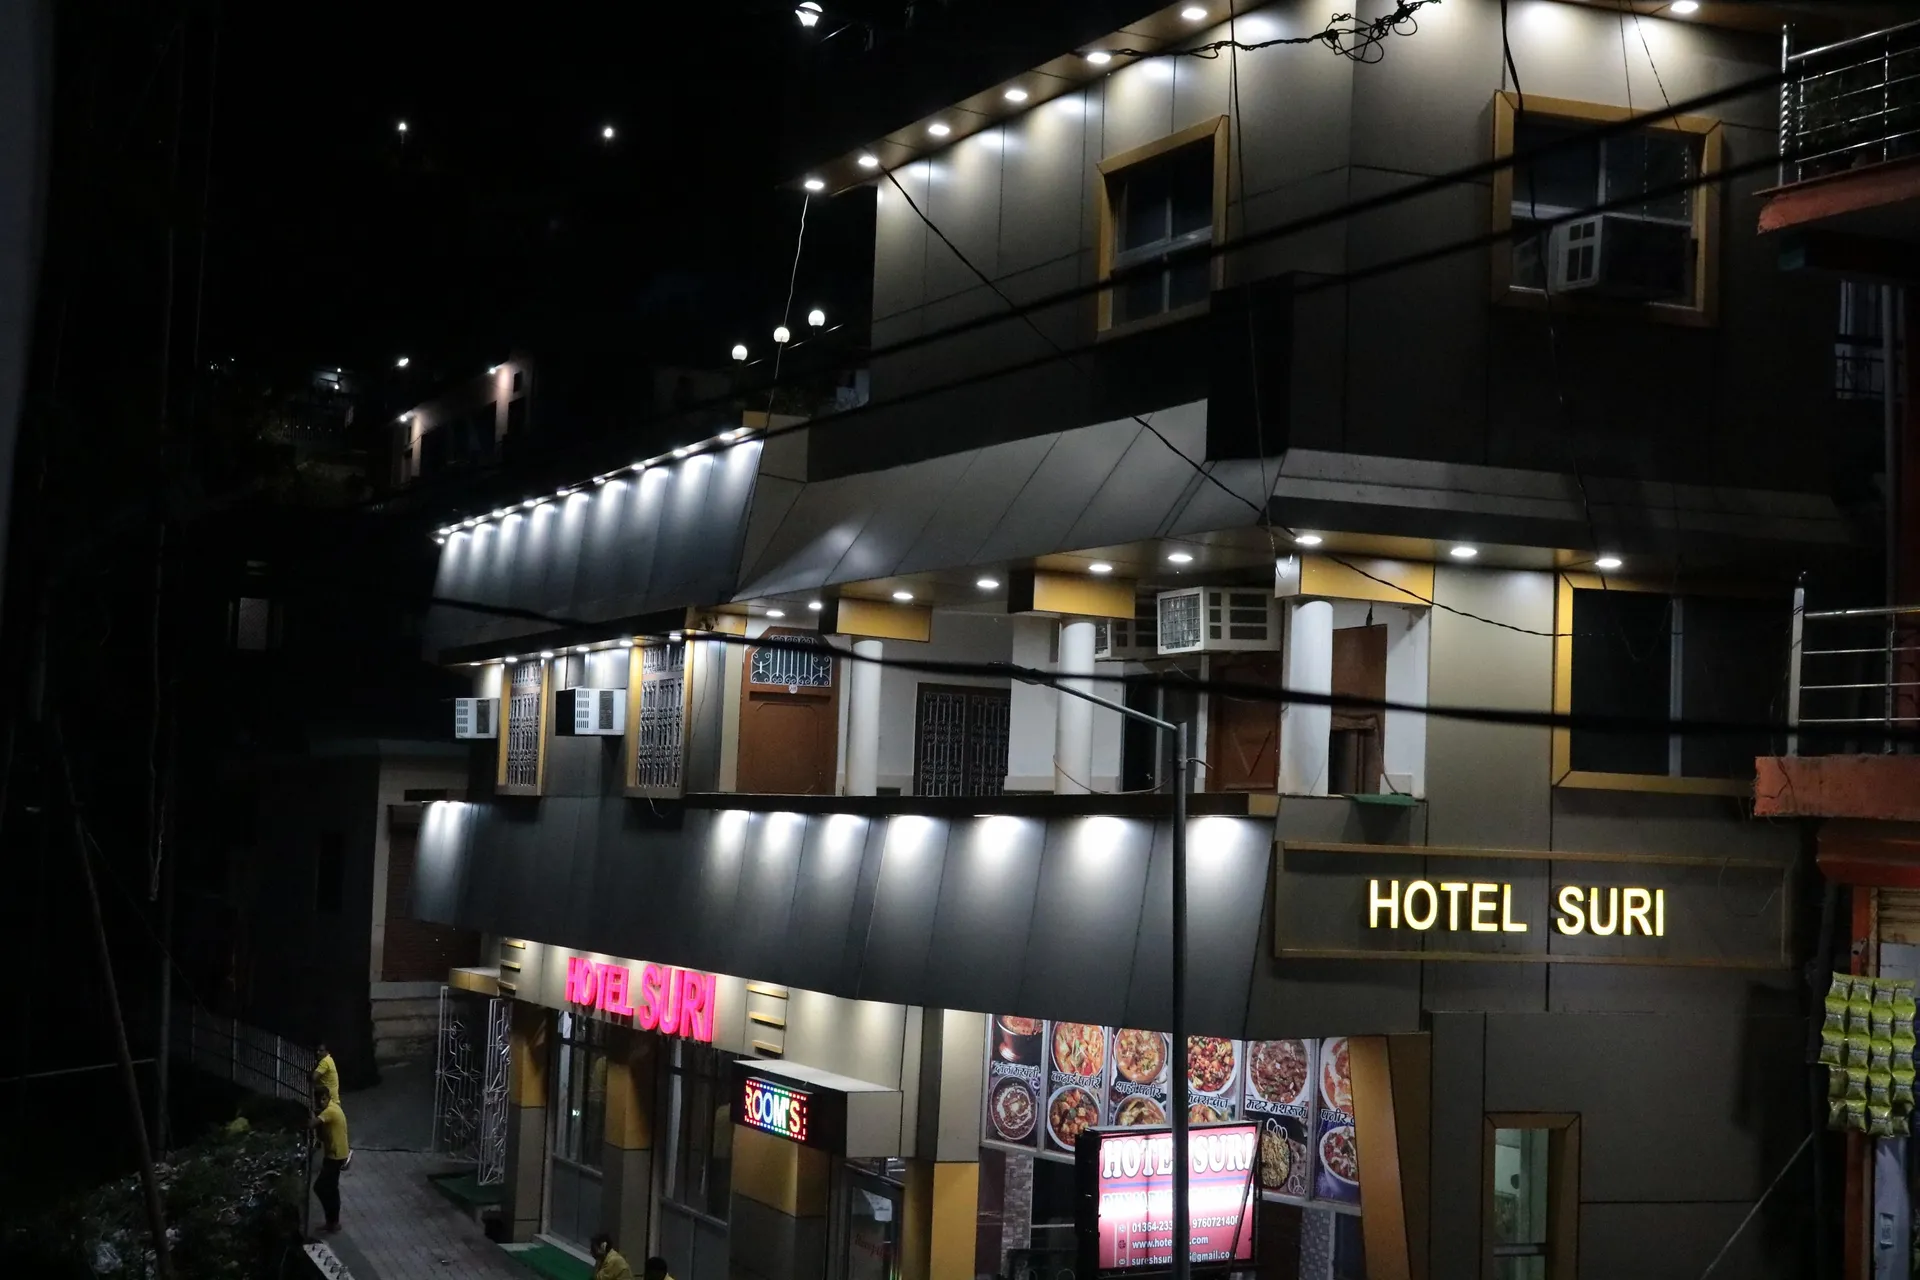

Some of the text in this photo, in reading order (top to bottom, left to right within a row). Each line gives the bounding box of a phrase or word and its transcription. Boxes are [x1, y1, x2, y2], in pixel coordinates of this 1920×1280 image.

[1369, 879, 1664, 937] HOTEL SURI
[564, 956, 717, 1043] HOTEL SURI
[1245, 1098, 1267, 1110] मटर
[1102, 1132, 1254, 1179] HOTE SURI
